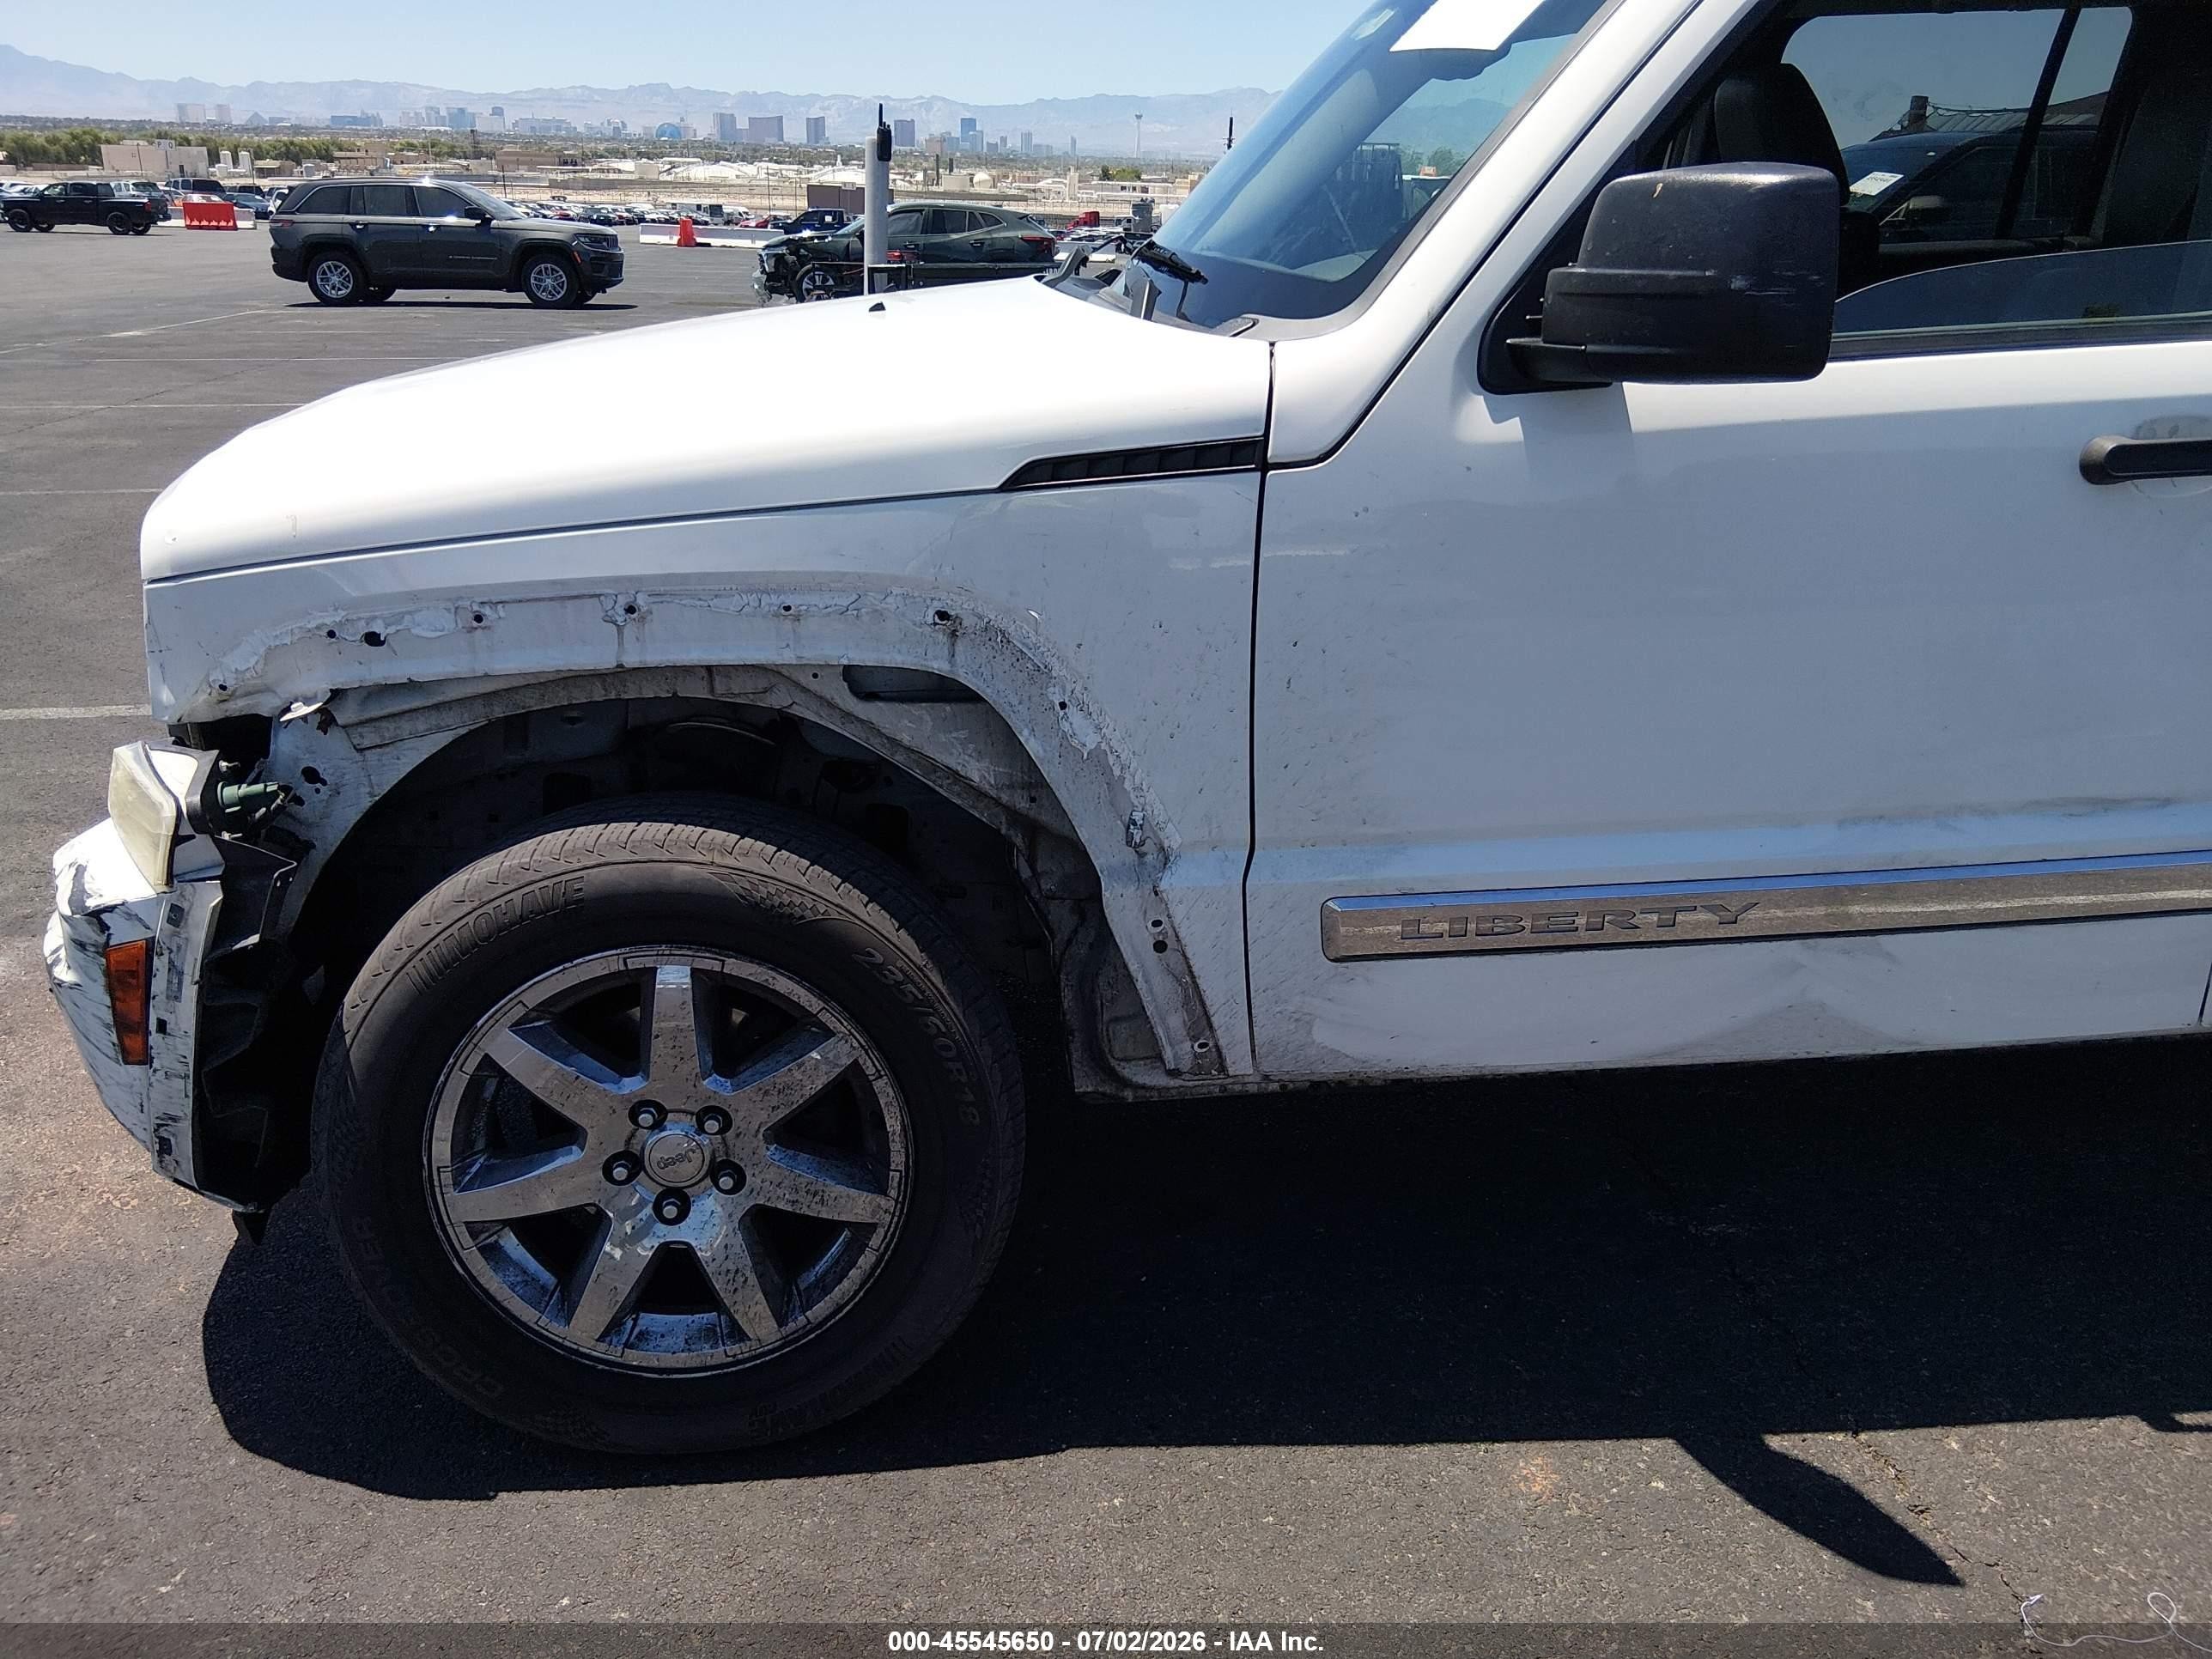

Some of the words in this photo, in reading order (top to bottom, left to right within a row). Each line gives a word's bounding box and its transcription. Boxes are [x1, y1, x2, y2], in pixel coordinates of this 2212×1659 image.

[440, 875, 585, 968] MOHAVE
[1400, 900, 1760, 940] LIBERTY
[850, 947, 981, 1127] 235/60R18
[656, 1147, 697, 1170] Jeep
